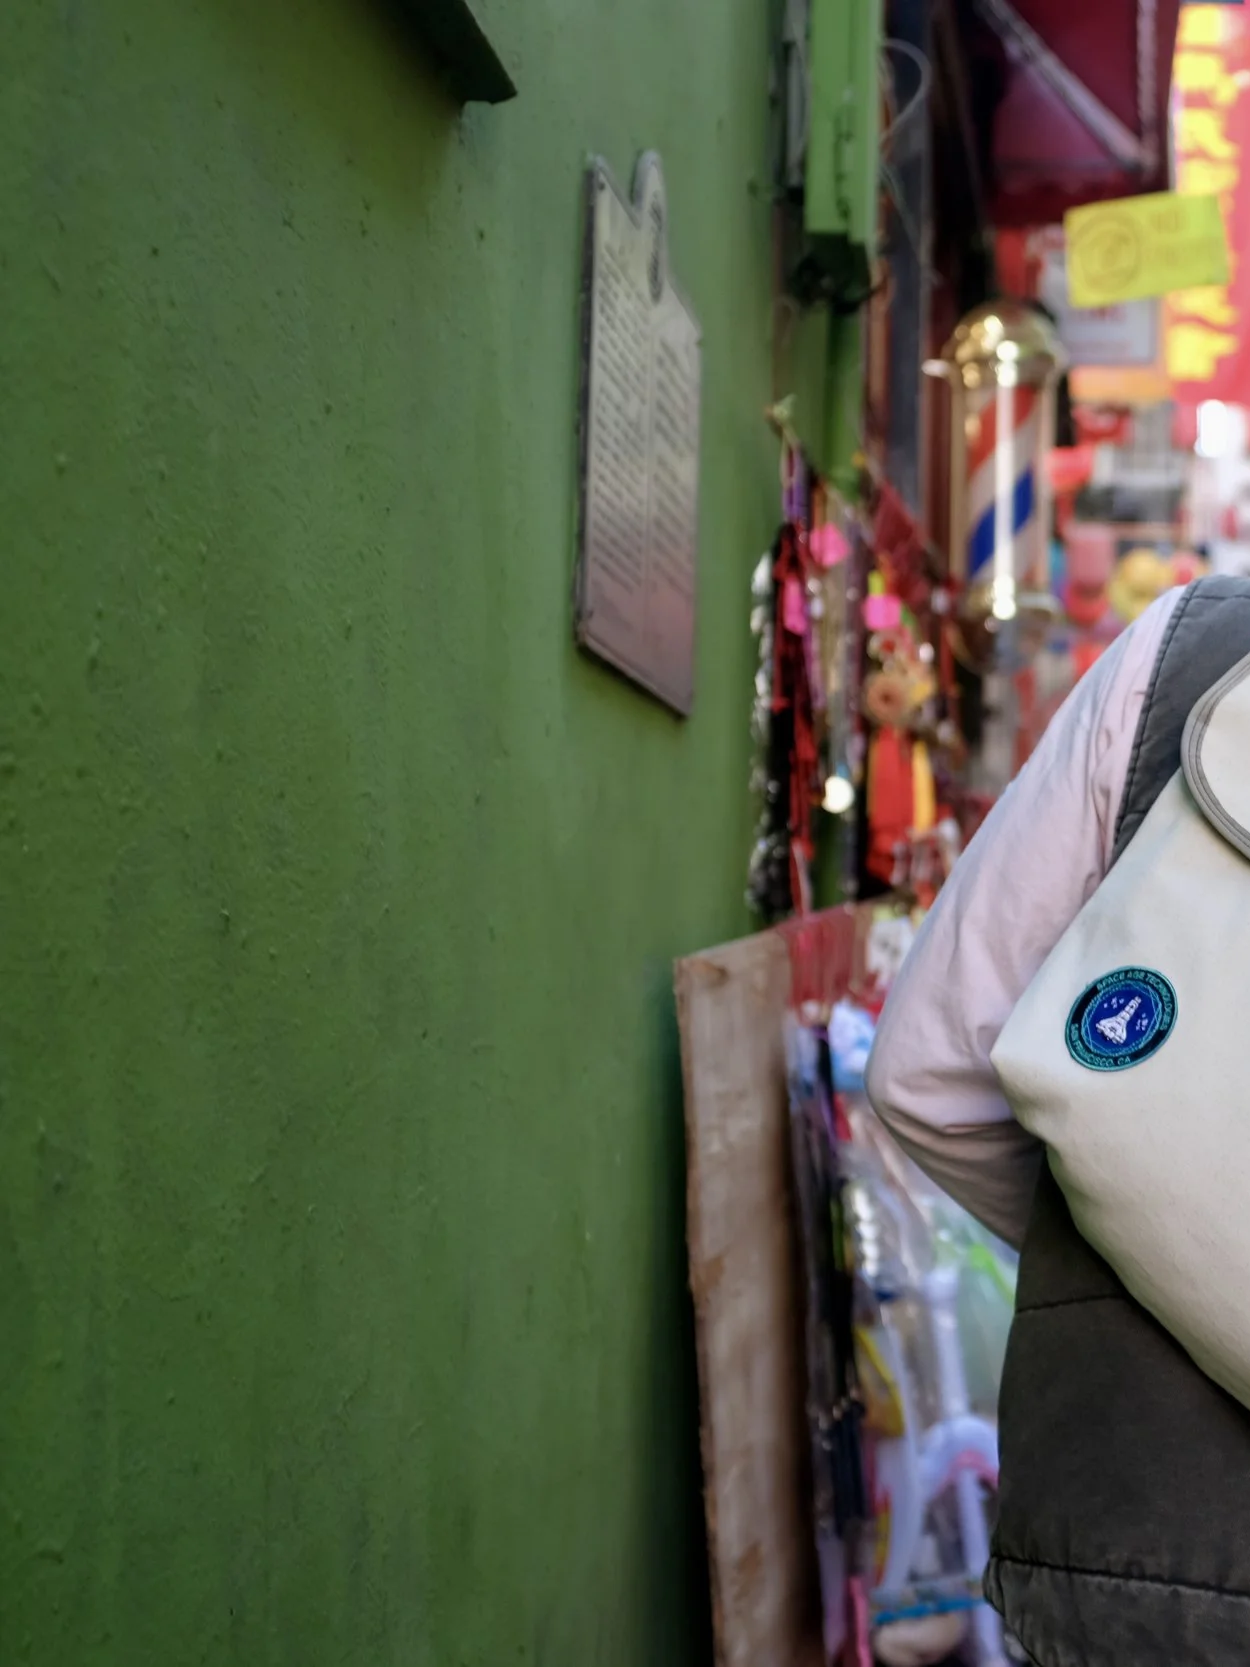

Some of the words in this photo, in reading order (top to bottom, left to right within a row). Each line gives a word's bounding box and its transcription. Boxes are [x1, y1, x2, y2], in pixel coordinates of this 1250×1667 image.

[1097, 973, 1125, 990] SPACE
[1127, 971, 1145, 979] AGE
[1117, 1056, 1131, 1065] CA
